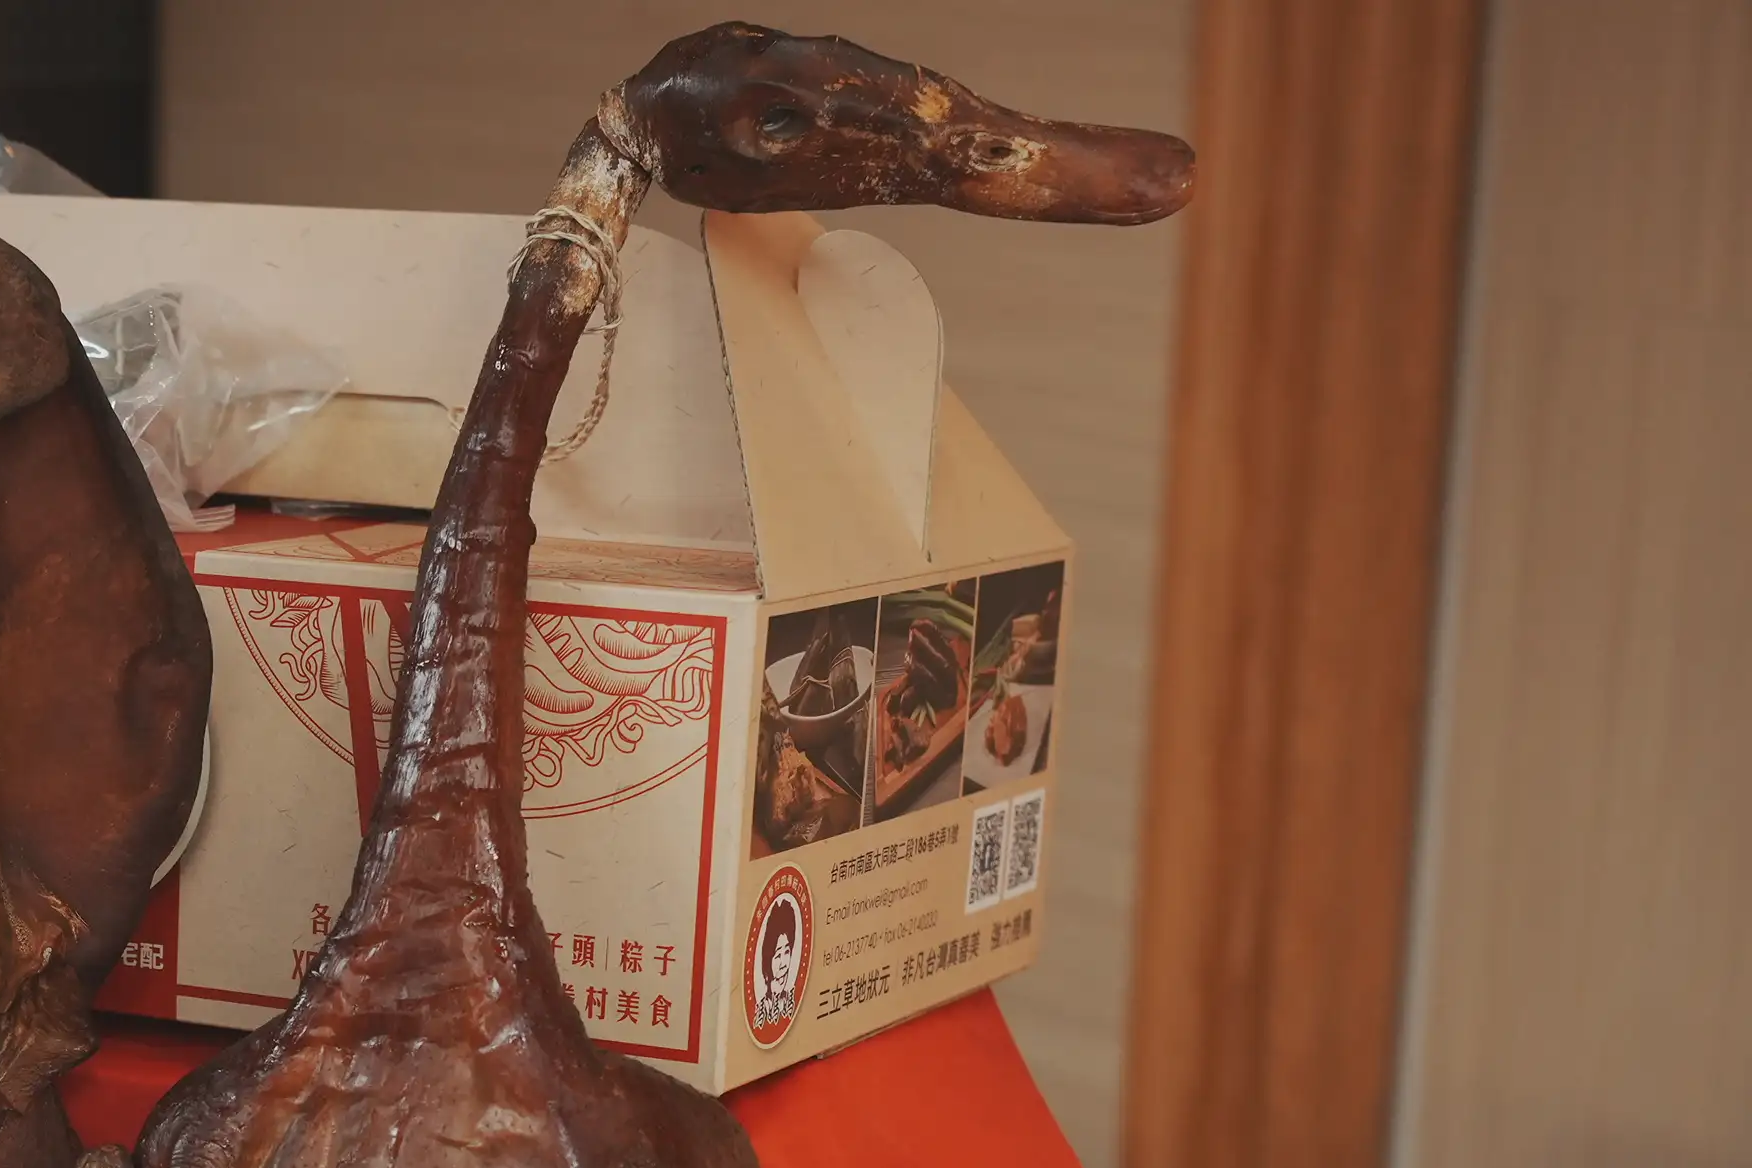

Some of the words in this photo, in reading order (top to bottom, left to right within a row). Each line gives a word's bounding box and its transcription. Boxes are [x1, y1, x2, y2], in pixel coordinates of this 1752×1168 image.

[620, 940, 676, 976] 粽子
[816, 965, 891, 1019] 三立草地狀元
